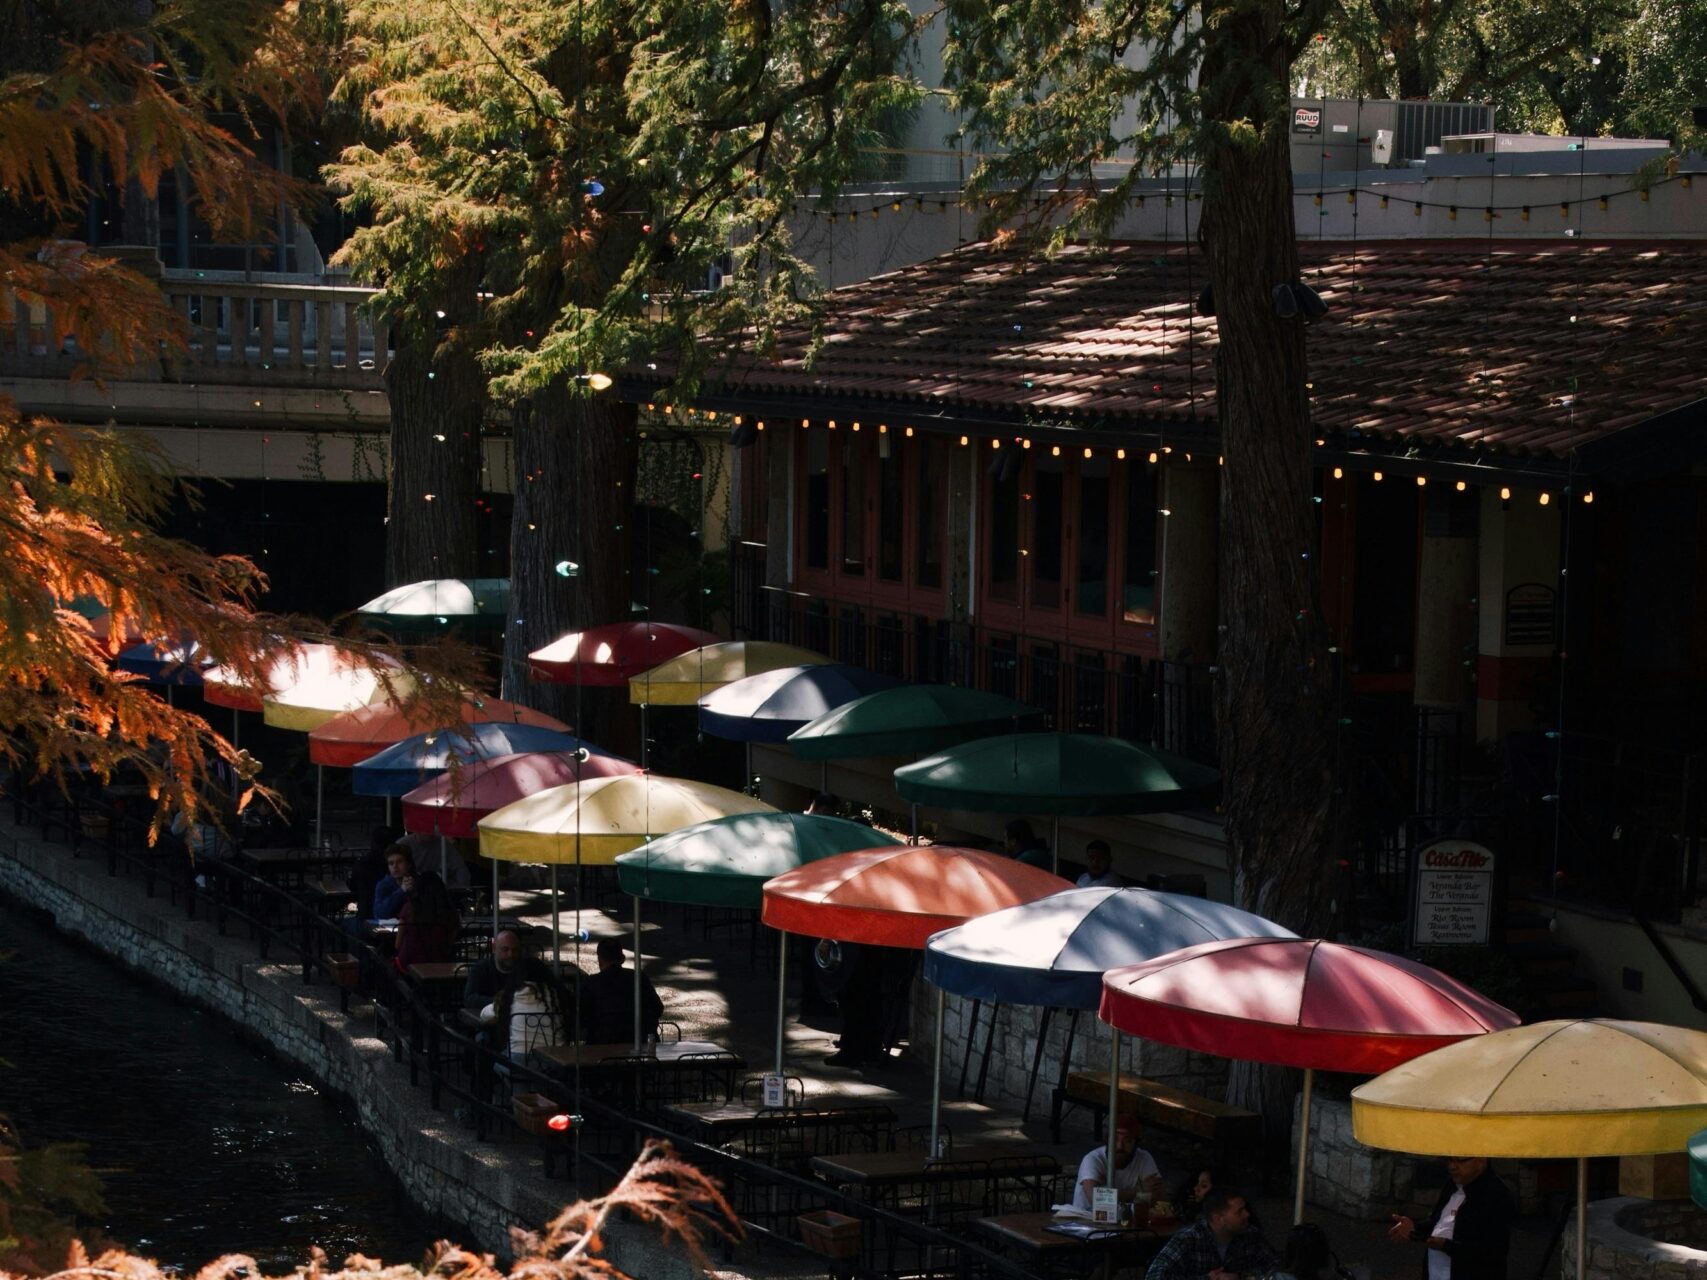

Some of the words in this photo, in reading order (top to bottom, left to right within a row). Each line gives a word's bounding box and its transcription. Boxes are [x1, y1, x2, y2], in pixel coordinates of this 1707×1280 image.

[1296, 114, 1319, 122] RUUD
[1425, 849, 1458, 867] Casa
[1459, 850, 1490, 868] Rio
[1428, 881, 1463, 890] Veranda
[1464, 881, 1481, 890] Bar
[1429, 890, 1445, 899] The
[1431, 914, 1447, 922] Rio
[1449, 914, 1474, 922] Room
[1451, 922, 1477, 930] Room
